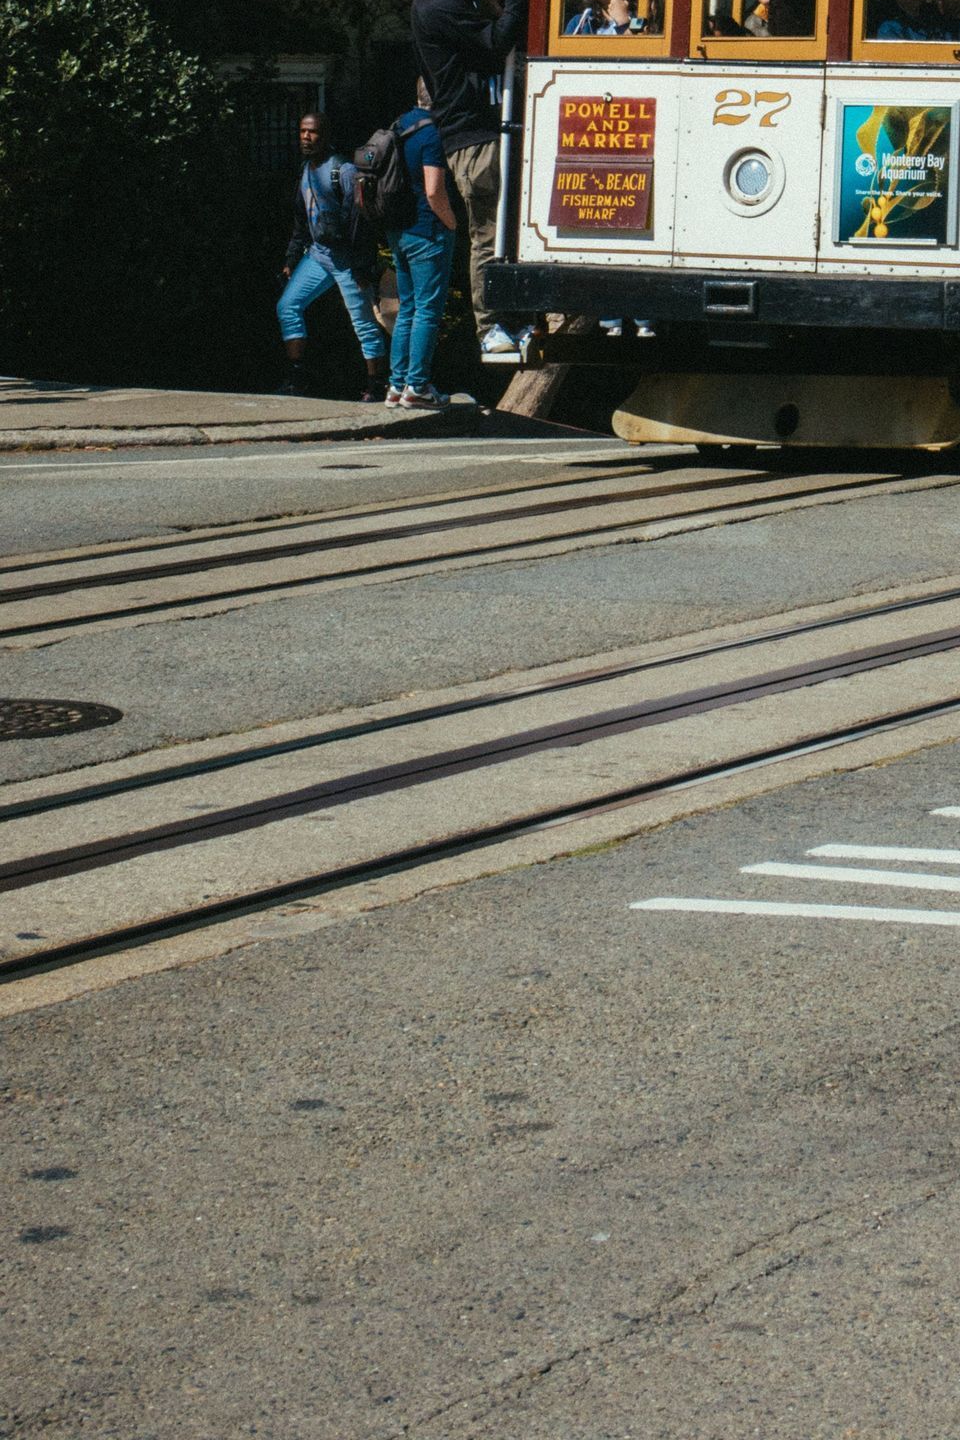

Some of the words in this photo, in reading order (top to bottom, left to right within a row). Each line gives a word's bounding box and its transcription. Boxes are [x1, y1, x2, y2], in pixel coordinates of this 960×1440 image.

[564, 102, 651, 119] POWELL
[713, 88, 792, 128] 27
[586, 120, 630, 132] AND
[561, 132, 652, 149] MARKET
[882, 153, 927, 169] Monterey
[928, 154, 945, 170] Bay
[556, 172, 588, 191] HYDE
[589, 173, 605, 190] AND
[606, 173, 647, 191] BEACH
[562, 193, 637, 208] FISHERMANS
[578, 207, 617, 220] WHARF
